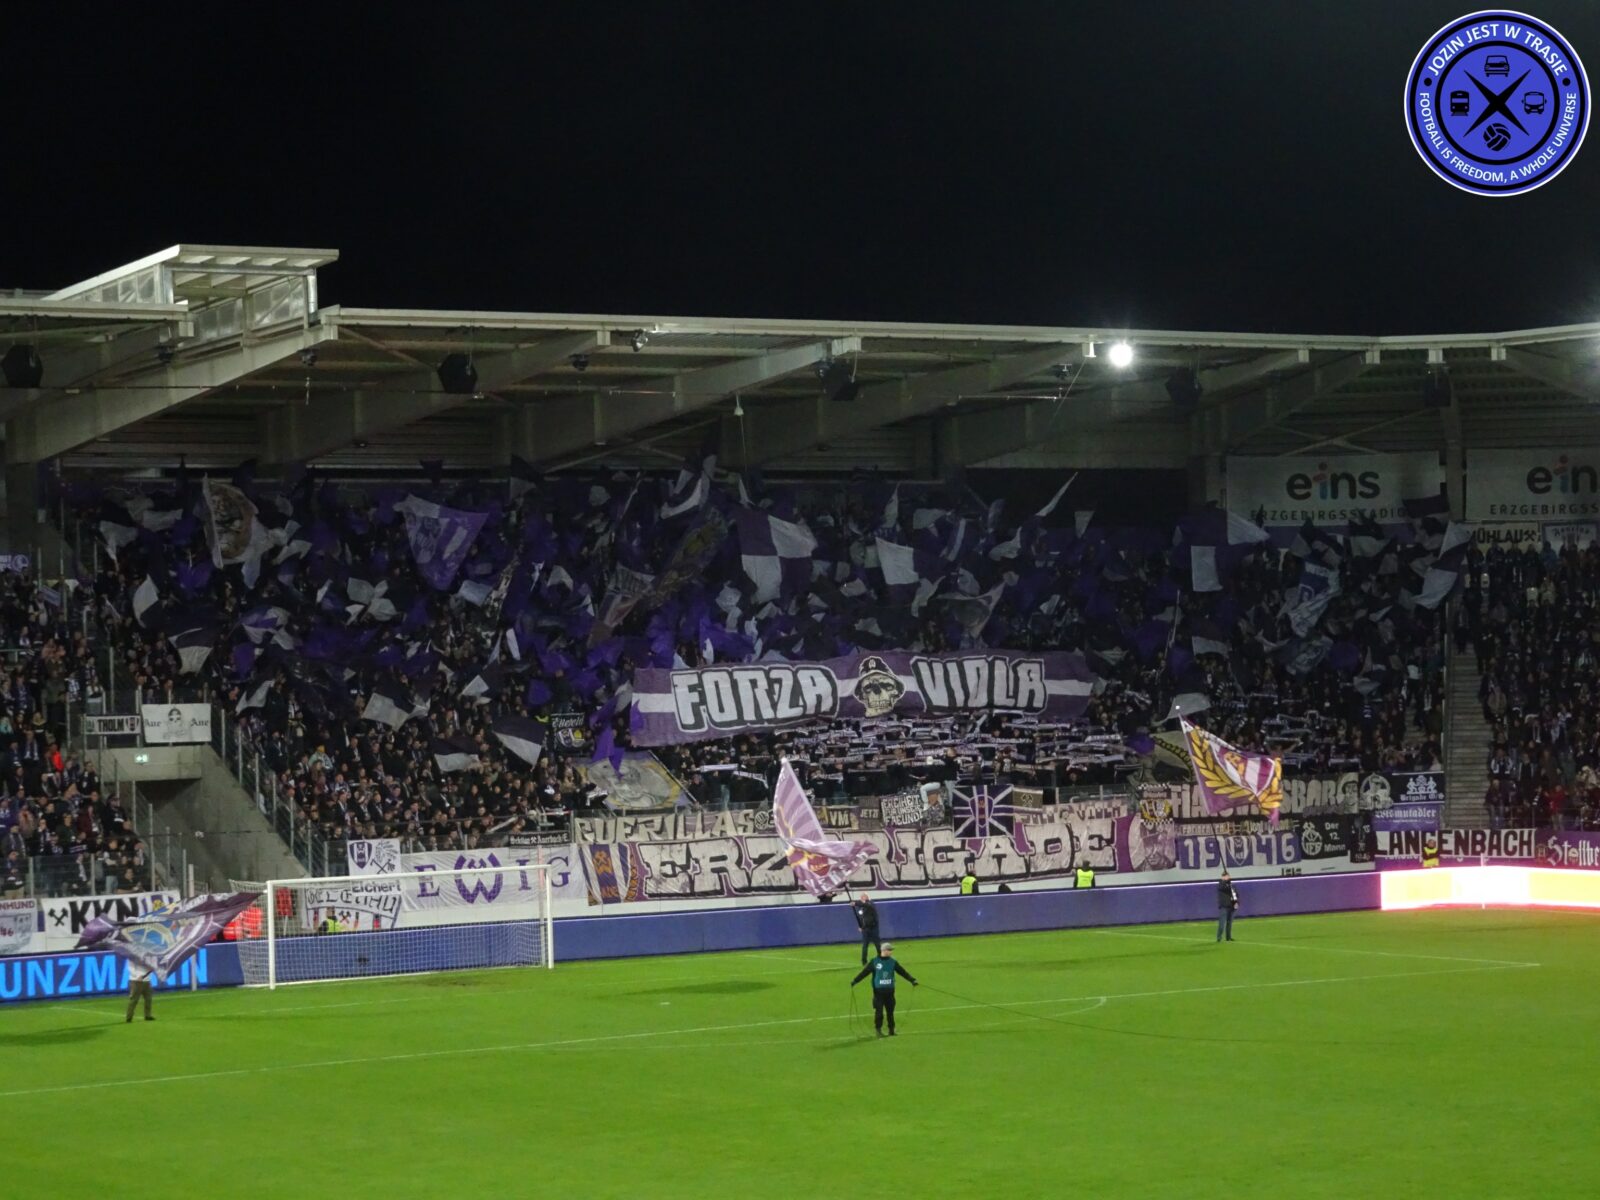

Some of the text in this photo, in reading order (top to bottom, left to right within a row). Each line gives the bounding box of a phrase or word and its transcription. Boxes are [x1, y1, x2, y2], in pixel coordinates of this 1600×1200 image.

[1286, 462, 1381, 500] eins
[670, 664, 839, 732] FORZA
[910, 655, 1048, 714] VIOLA
[575, 808, 756, 844] GUERILLAS
[639, 816, 1117, 897] ERZRIGADE
[0, 948, 208, 999] UNZMN
